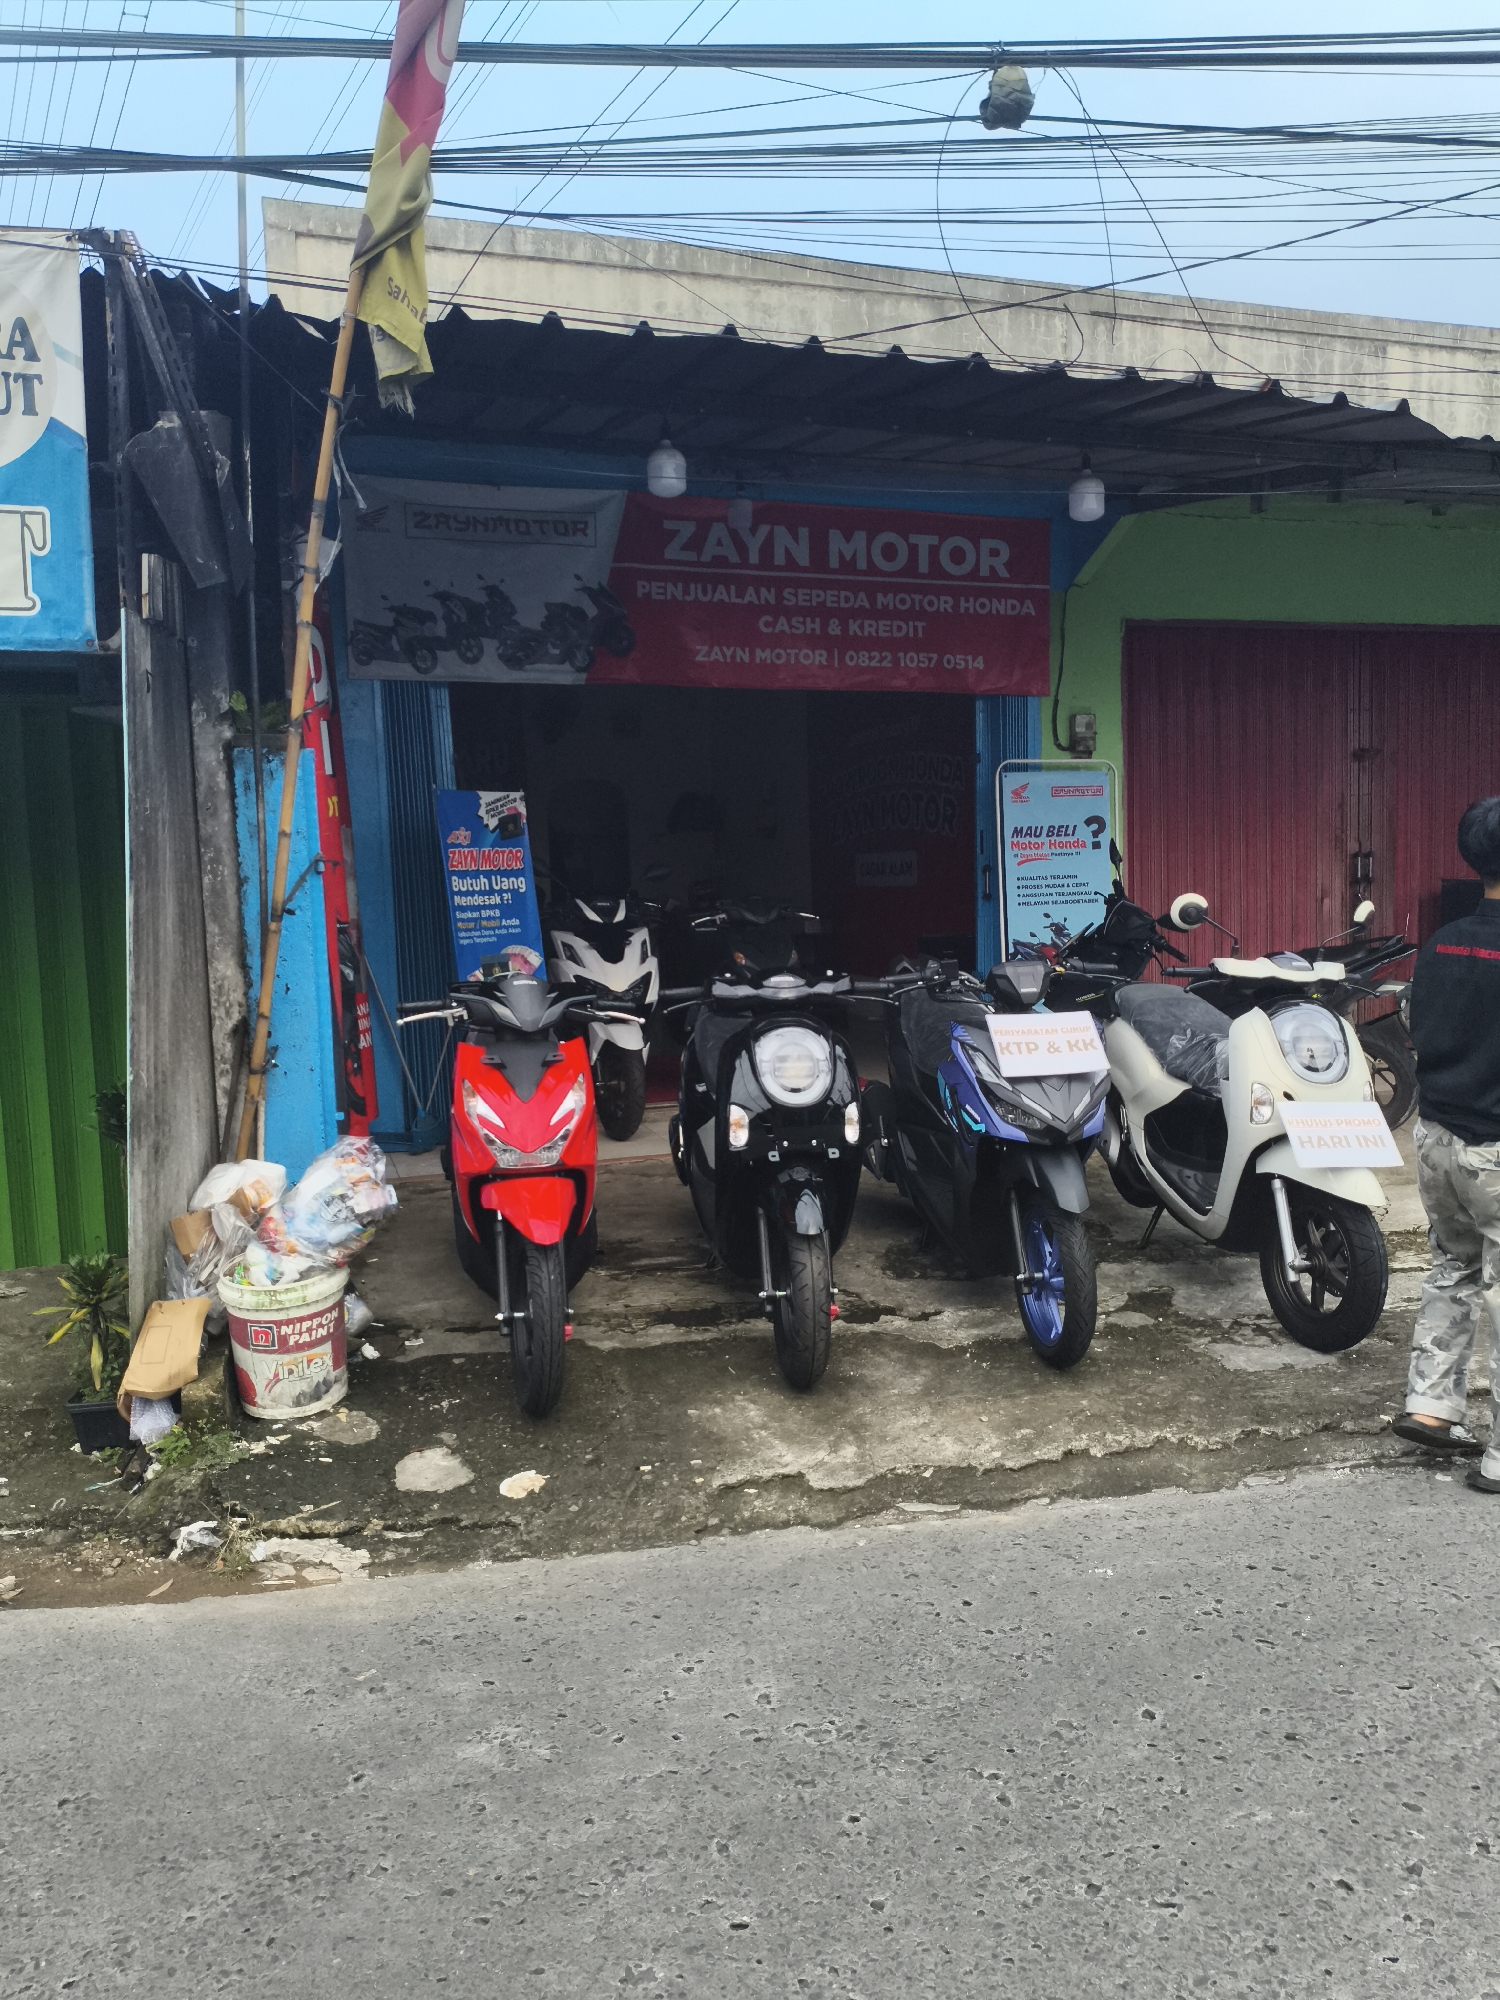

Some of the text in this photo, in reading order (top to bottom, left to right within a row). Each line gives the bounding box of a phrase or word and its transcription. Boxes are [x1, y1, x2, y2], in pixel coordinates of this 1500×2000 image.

[0, 316, 41, 362] A
[413, 510, 589, 538] ZAYNMOTOR
[663, 520, 1012, 578] ZAYN MOTOR
[636, 580, 1036, 617] PENJUALAN SEPEDA MOTOR HONDA
[758, 615, 927, 639] CASH & KREDIT
[695, 644, 751, 664] ZAYN
[755, 646, 829, 667] MOTOR
[845, 648, 894, 668] 0822
[898, 650, 939, 669] 1057
[943, 652, 985, 671] 0514
[1011, 825, 1044, 839] MAU
[1046, 824, 1077, 838] BELI
[1010, 838, 1087, 852] Motor Honda
[448, 848, 524, 871] ZAYN MOTOR
[452, 875, 526, 893] Butuh Uang
[454, 895, 501, 907] Mendesak
[455, 909, 500, 920] Siapkan BPKB
[501, 918, 520, 926] Anda
[993, 1025, 1092, 1037] PERSYARATAN CUKUP
[998, 1037, 1098, 1056] KTP & KK
[1287, 1117, 1382, 1128] KHUSUS PROMO
[1298, 1134, 1388, 1149] HARI INI
[280, 1307, 339, 1335] NIPPON
[288, 1321, 335, 1346] PAINT
[262, 1353, 334, 1380] Vinilex
